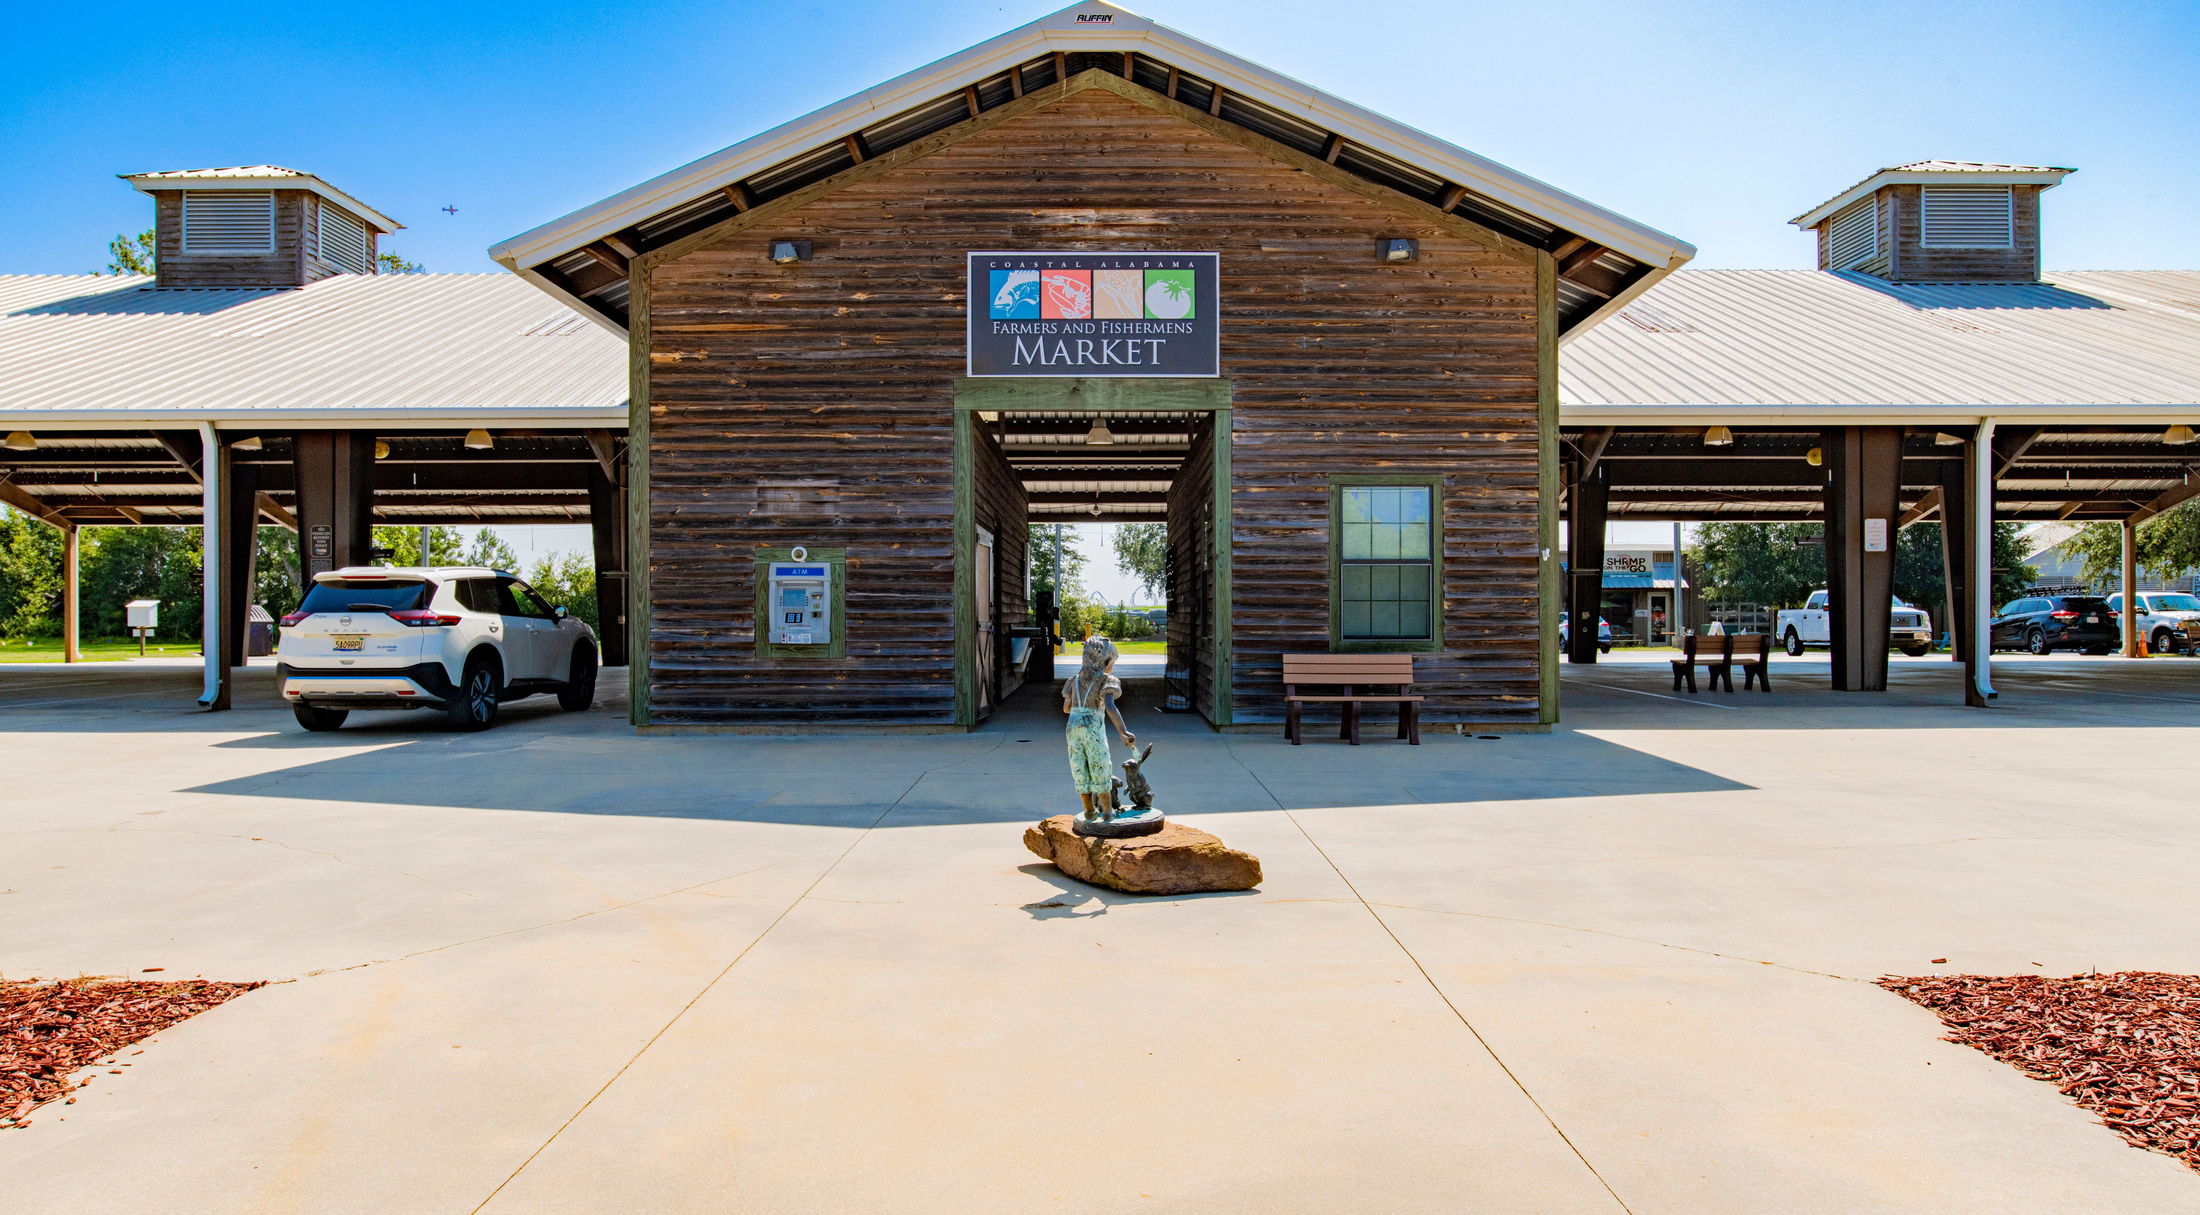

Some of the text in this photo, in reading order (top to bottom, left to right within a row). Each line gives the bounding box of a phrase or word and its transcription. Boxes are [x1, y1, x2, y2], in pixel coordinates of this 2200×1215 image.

[1076, 14, 1113, 22] RUFFIN
[993, 321, 1193, 334] FARMERS AND FISHERMENS
[1011, 335, 1167, 366] MARKET
